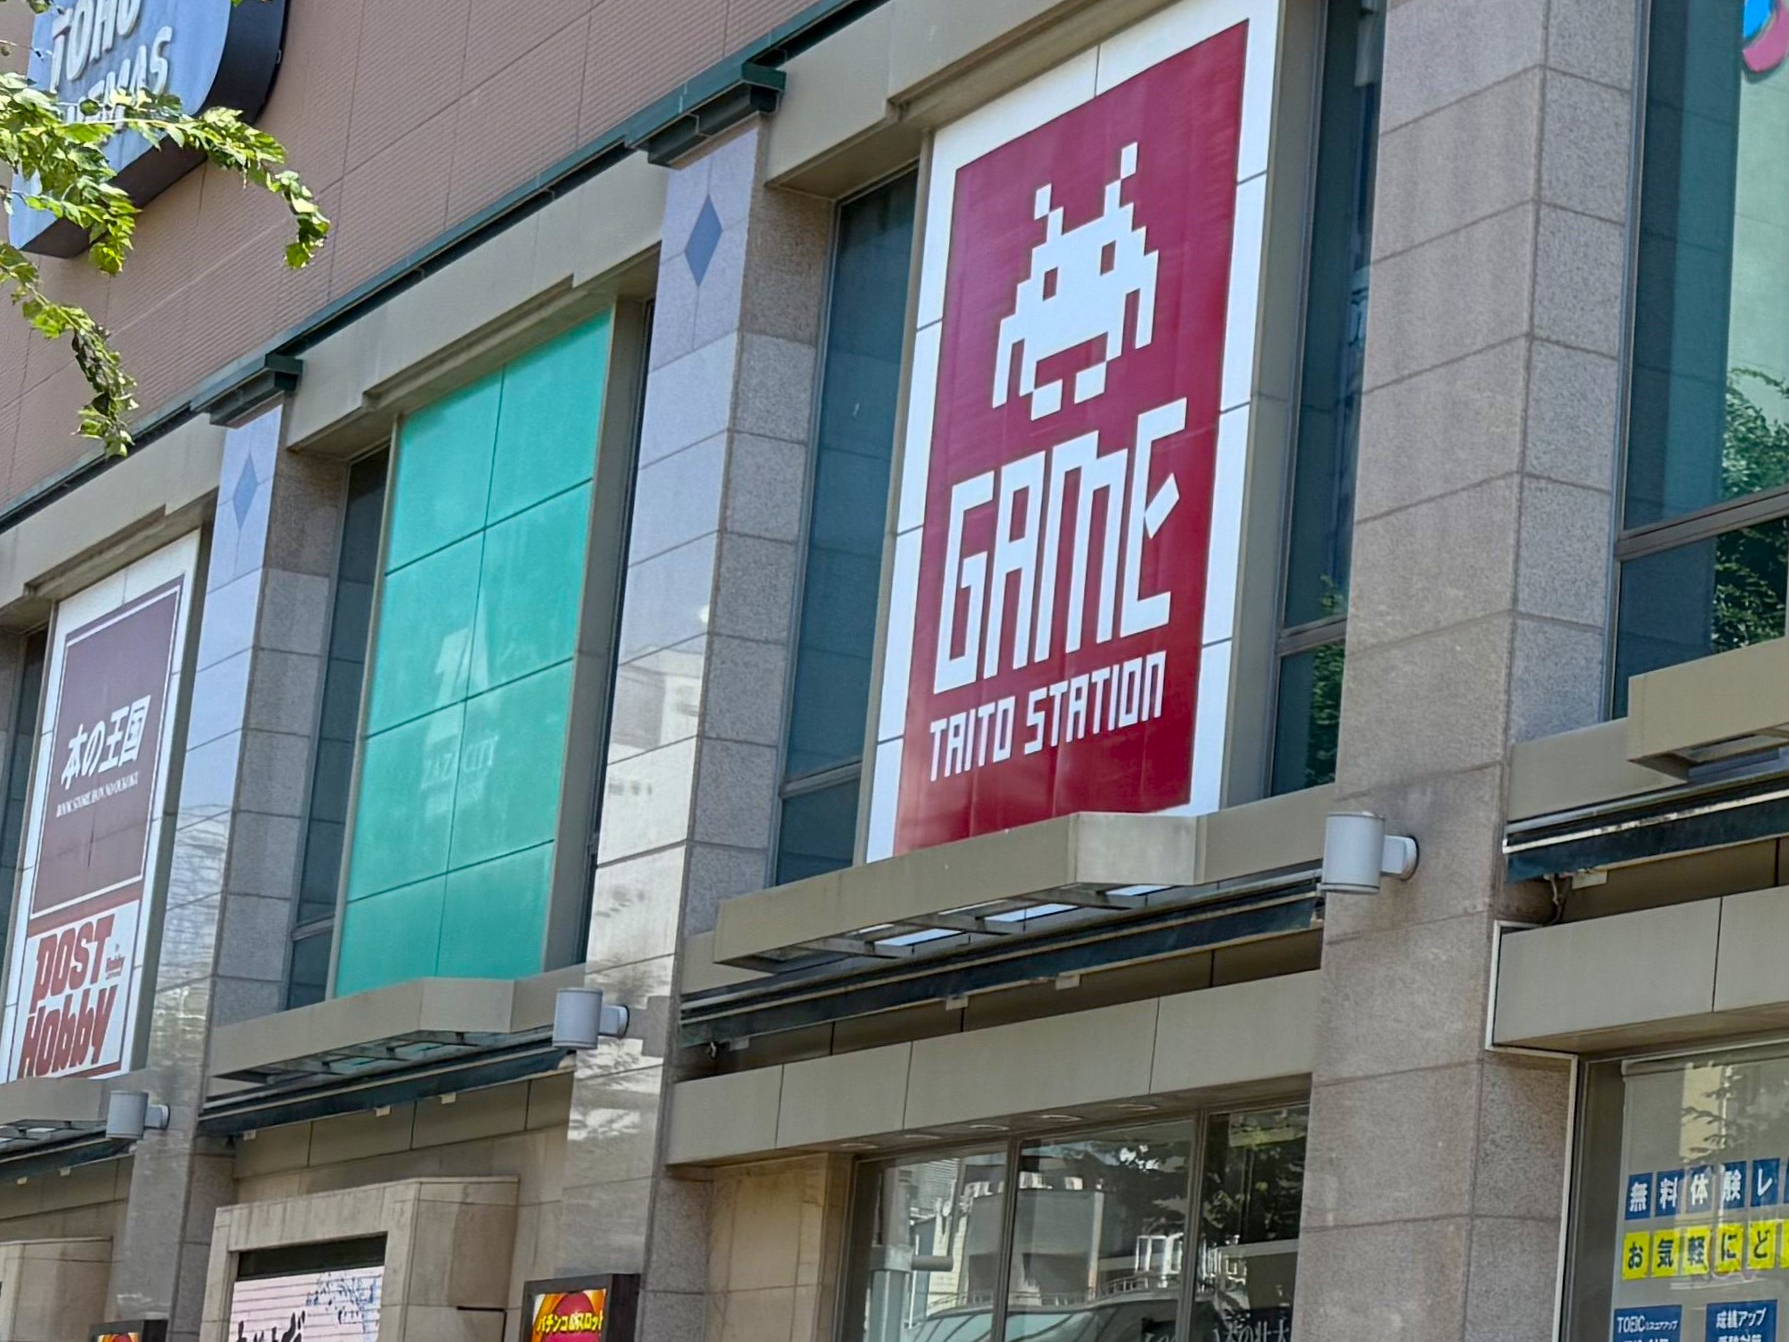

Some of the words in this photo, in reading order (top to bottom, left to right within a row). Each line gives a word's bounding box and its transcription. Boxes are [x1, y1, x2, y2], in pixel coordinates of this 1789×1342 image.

[934, 397, 1188, 695] GAME
[60, 693, 151, 791] 本の王国
[929, 695, 1017, 782] TAITO
[1024, 650, 1167, 756] STATION
[29, 913, 116, 1015] POST
[17, 984, 118, 1079] Hobby
